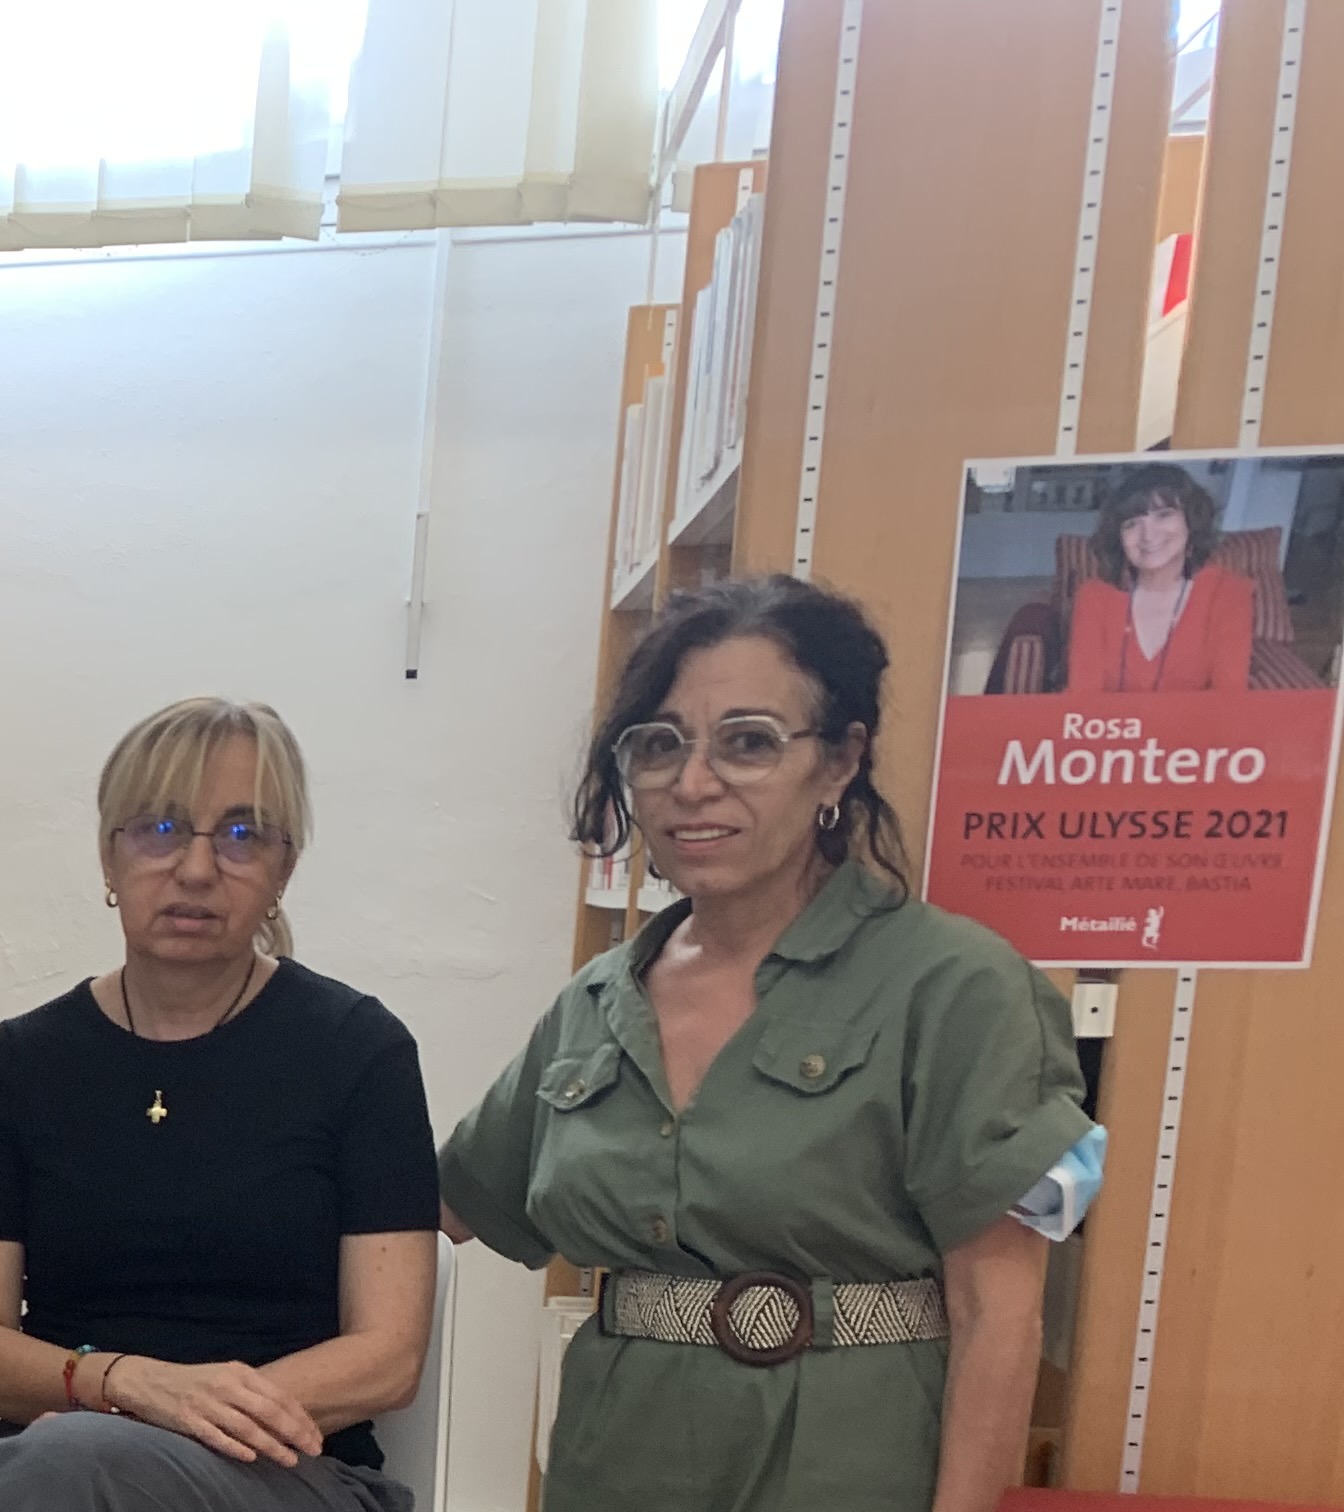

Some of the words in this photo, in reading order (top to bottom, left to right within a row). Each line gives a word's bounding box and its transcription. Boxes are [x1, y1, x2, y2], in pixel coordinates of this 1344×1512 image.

[1063, 712, 1142, 740] Rosa
[997, 738, 1267, 785] Montero
[963, 811, 1046, 840] PRIX
[1059, 810, 1194, 839] ULYSSE
[1204, 809, 1289, 839] 2021
[961, 853, 1012, 870] POUR
[1136, 853, 1161, 869] DE
[1167, 852, 1208, 868] SON
[985, 876, 1065, 892] FESTIVAL
[1071, 876, 1113, 891] ARTE
[1186, 875, 1252, 892] BASTIA
